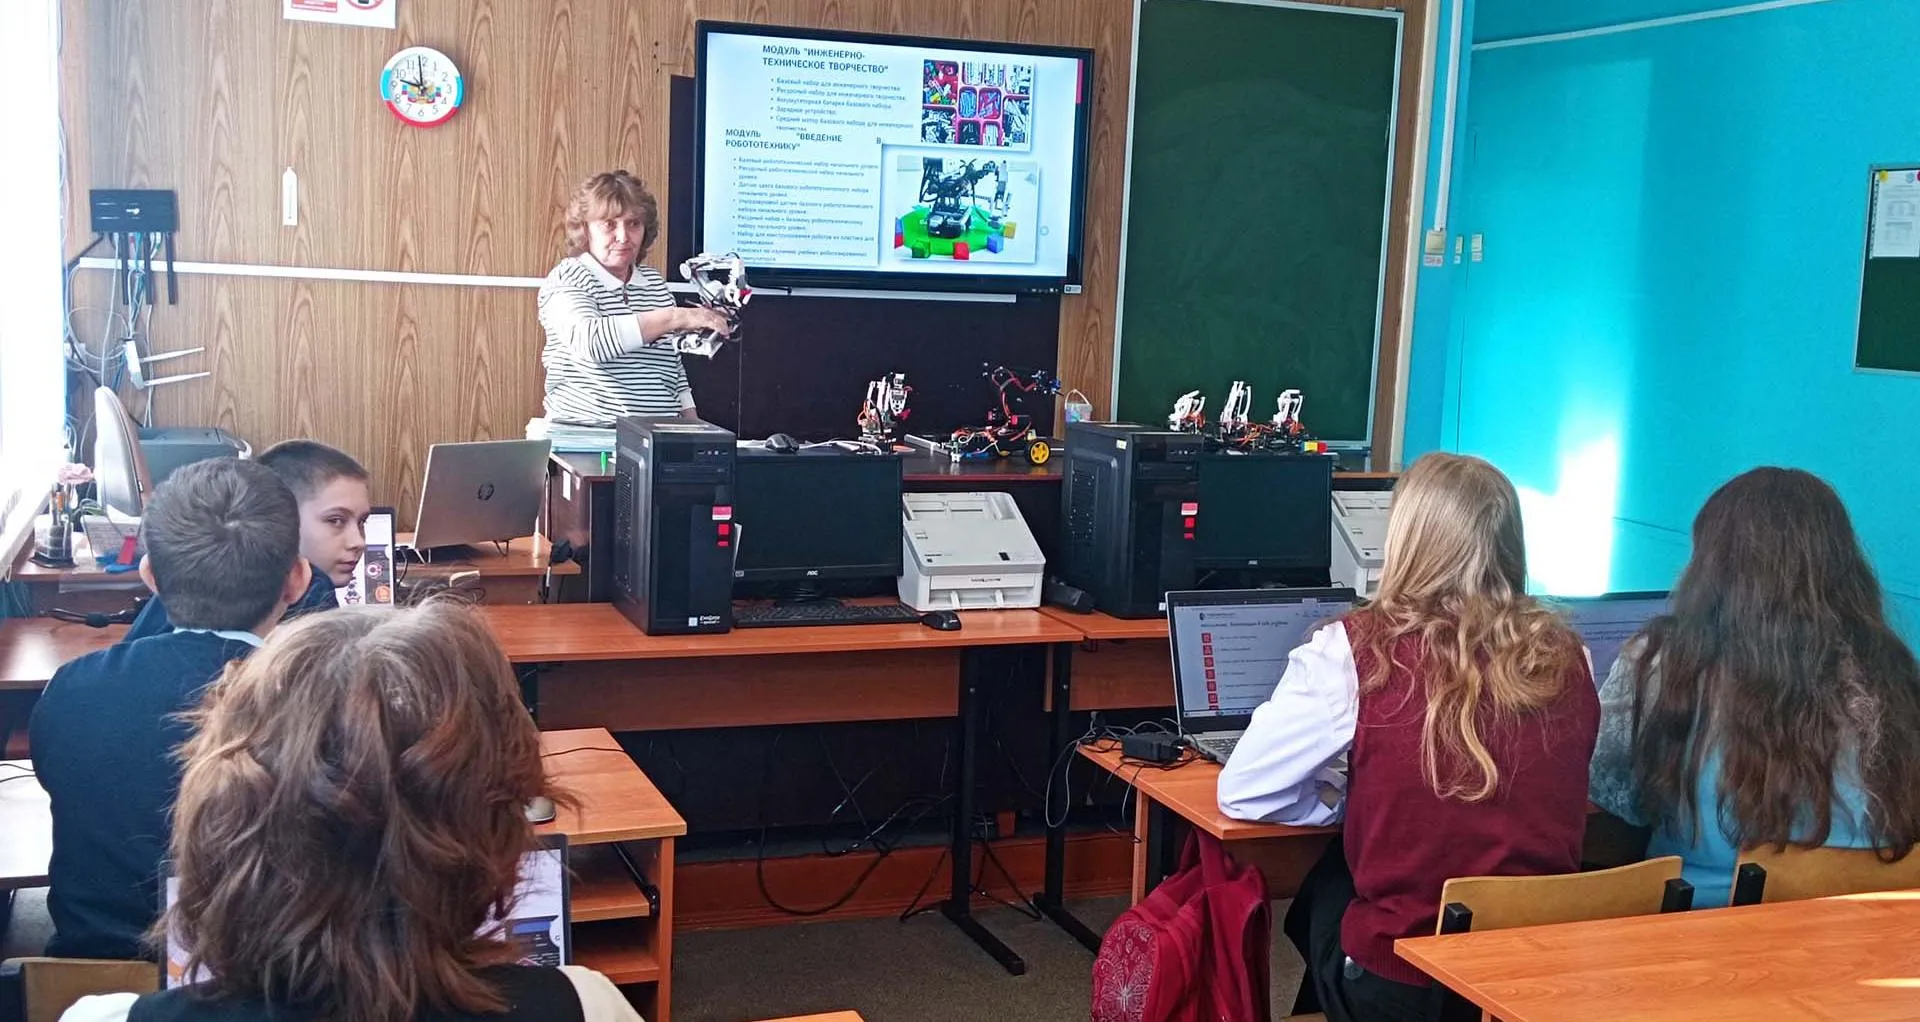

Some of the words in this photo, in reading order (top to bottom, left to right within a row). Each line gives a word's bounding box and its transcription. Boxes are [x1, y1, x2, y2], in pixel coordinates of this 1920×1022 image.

[762, 44, 801, 56] МОДУЛЬ
[803, 47, 866, 61] "ИНЖЕНЕРНО-
[762, 57, 826, 70] ТЕХНИЧЕСКОЕ
[829, 61, 889, 74] ТВОРЧЕСТВО"
[725, 128, 761, 139] МОДУЛЬ
[796, 132, 843, 143] "ВВЕДЕНИЕ
[725, 139, 801, 151] РОБОТОТЕХНИКУ"
